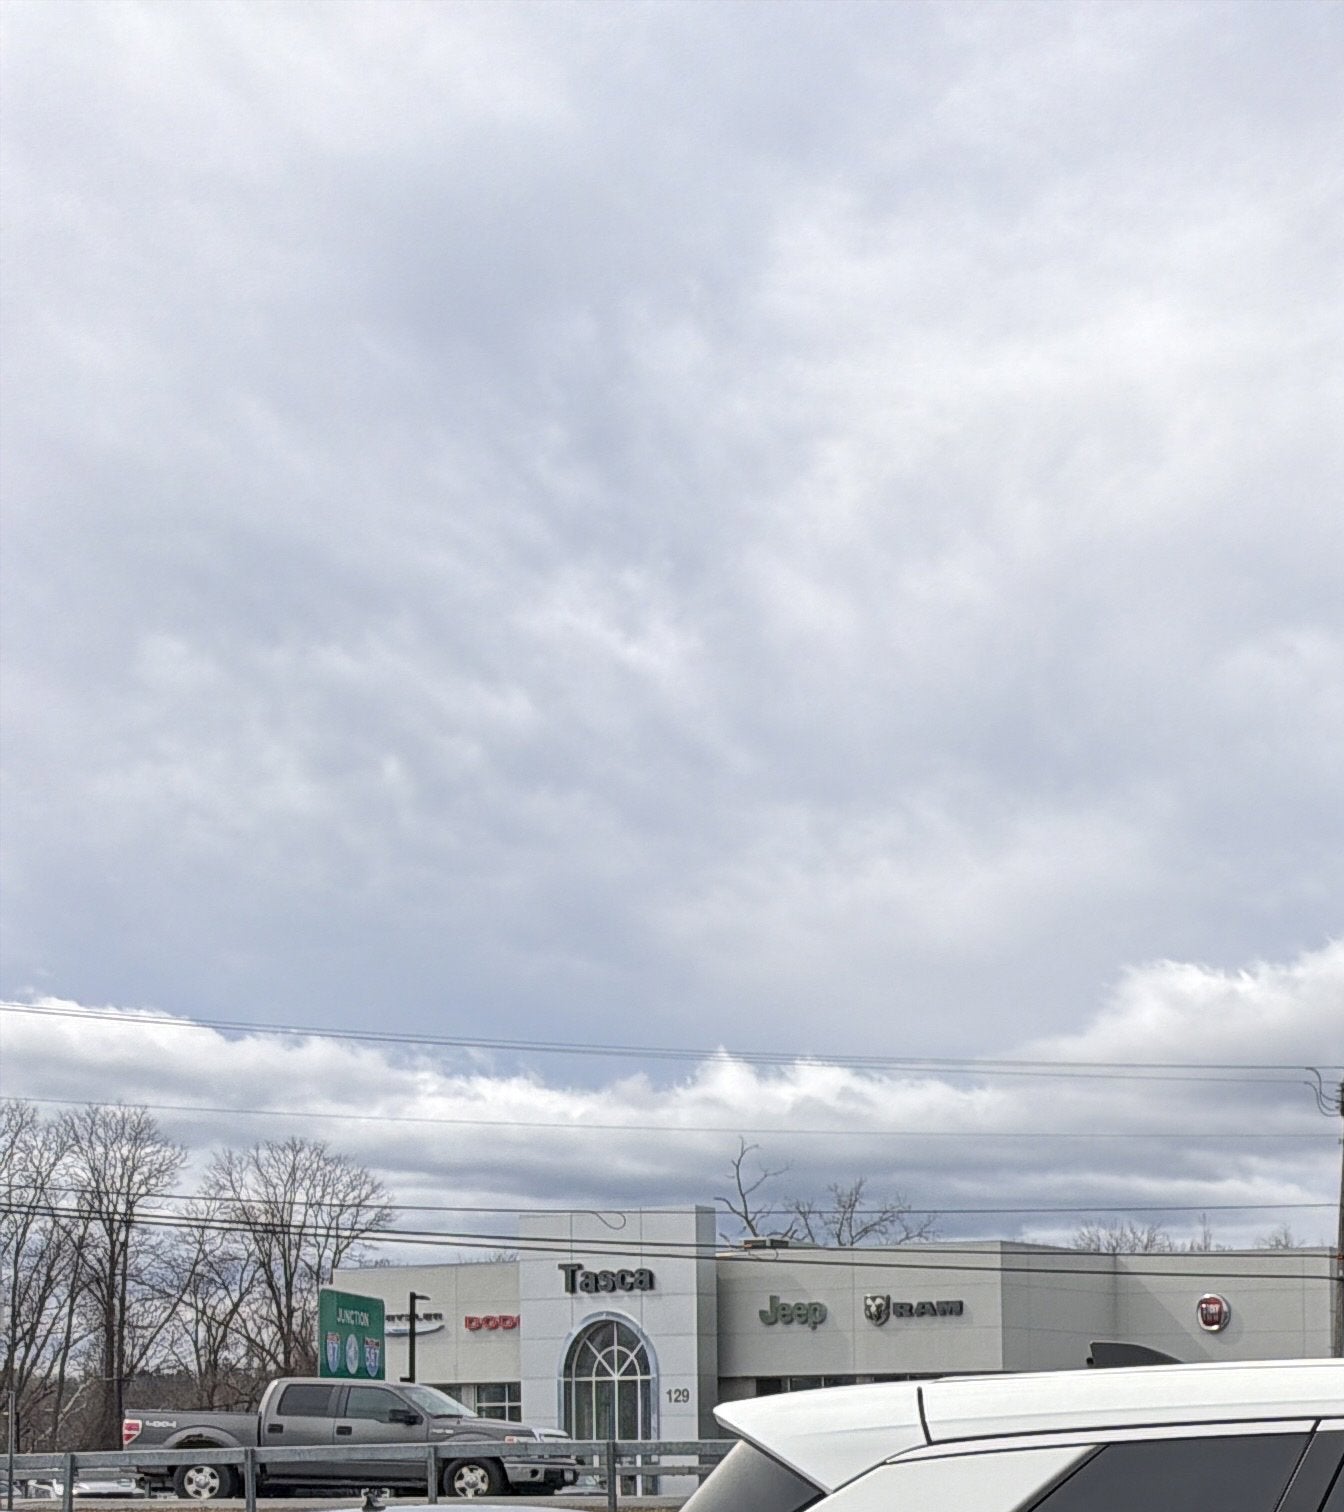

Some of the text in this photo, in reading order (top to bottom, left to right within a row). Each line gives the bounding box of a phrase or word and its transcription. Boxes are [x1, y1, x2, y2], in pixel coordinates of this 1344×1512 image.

[558, 1263, 655, 1295] Tasca
[337, 1308, 370, 1327] JUNCTION
[759, 1295, 828, 1331] Jeep
[893, 1300, 964, 1318] RAM
[464, 1314, 520, 1331] DOD
[666, 1388, 690, 1404] 129
